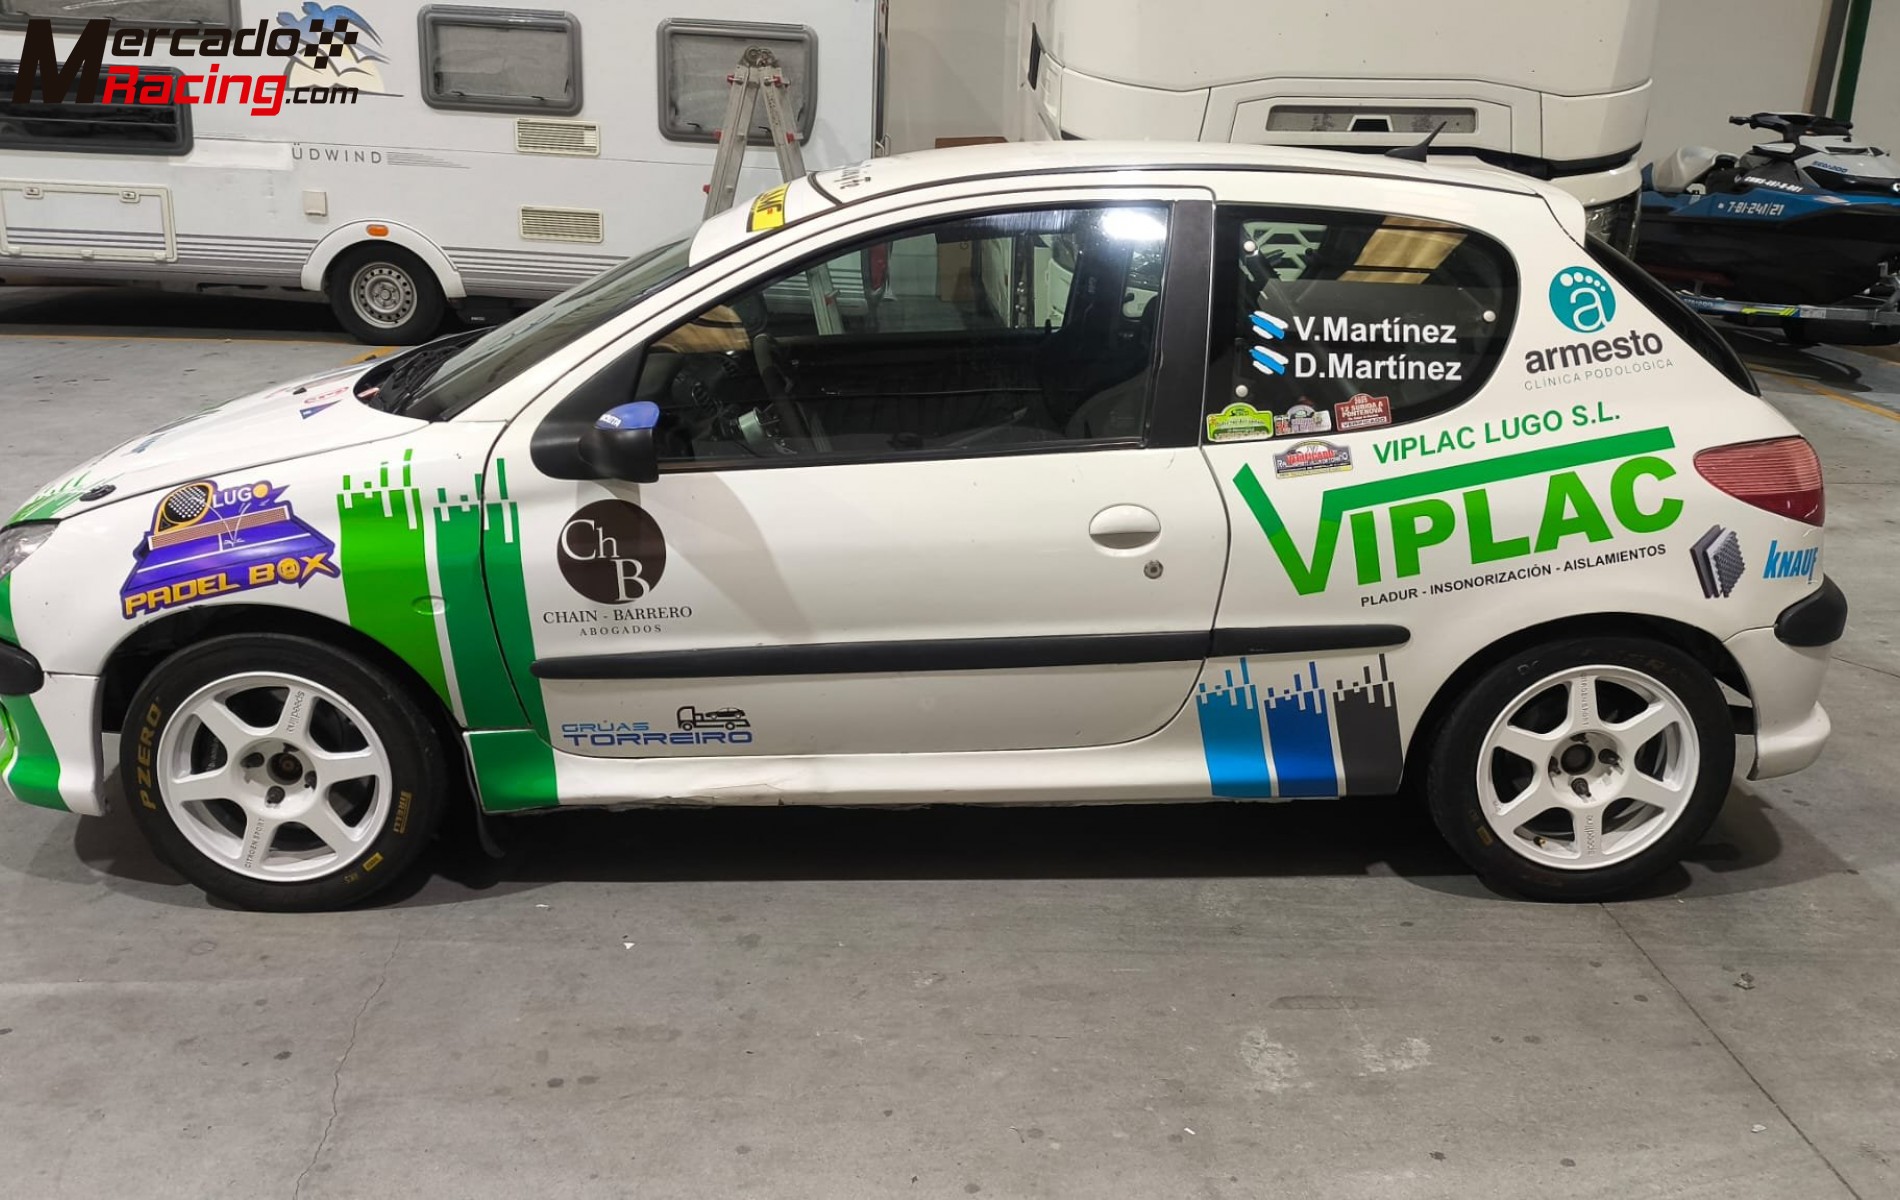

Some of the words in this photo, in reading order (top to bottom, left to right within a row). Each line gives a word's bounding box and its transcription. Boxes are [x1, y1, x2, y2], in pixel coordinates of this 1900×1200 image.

[1293, 316, 1457, 344] V.Martínez
[1295, 352, 1462, 381] D.Martínez
[1525, 330, 1663, 374] armesto
[1373, 425, 1477, 465] VIPLAC
[1485, 410, 1564, 444] LUGO
[1571, 401, 1621, 427] S.L.
[1233, 427, 1684, 596] VIPLAC
[125, 573, 241, 617] PADEL
[249, 552, 335, 585] BOX
[1360, 588, 1419, 608] PLADUR
[1430, 563, 1552, 595] INSONORIZACIÓN
[1563, 543, 1667, 573] AISLAMIENTOS
[543, 610, 598, 625] CHAIN
[614, 606, 693, 622] BARRERO
[579, 624, 662, 637] ABOGADOS
[563, 731, 753, 747] TORREIRO
